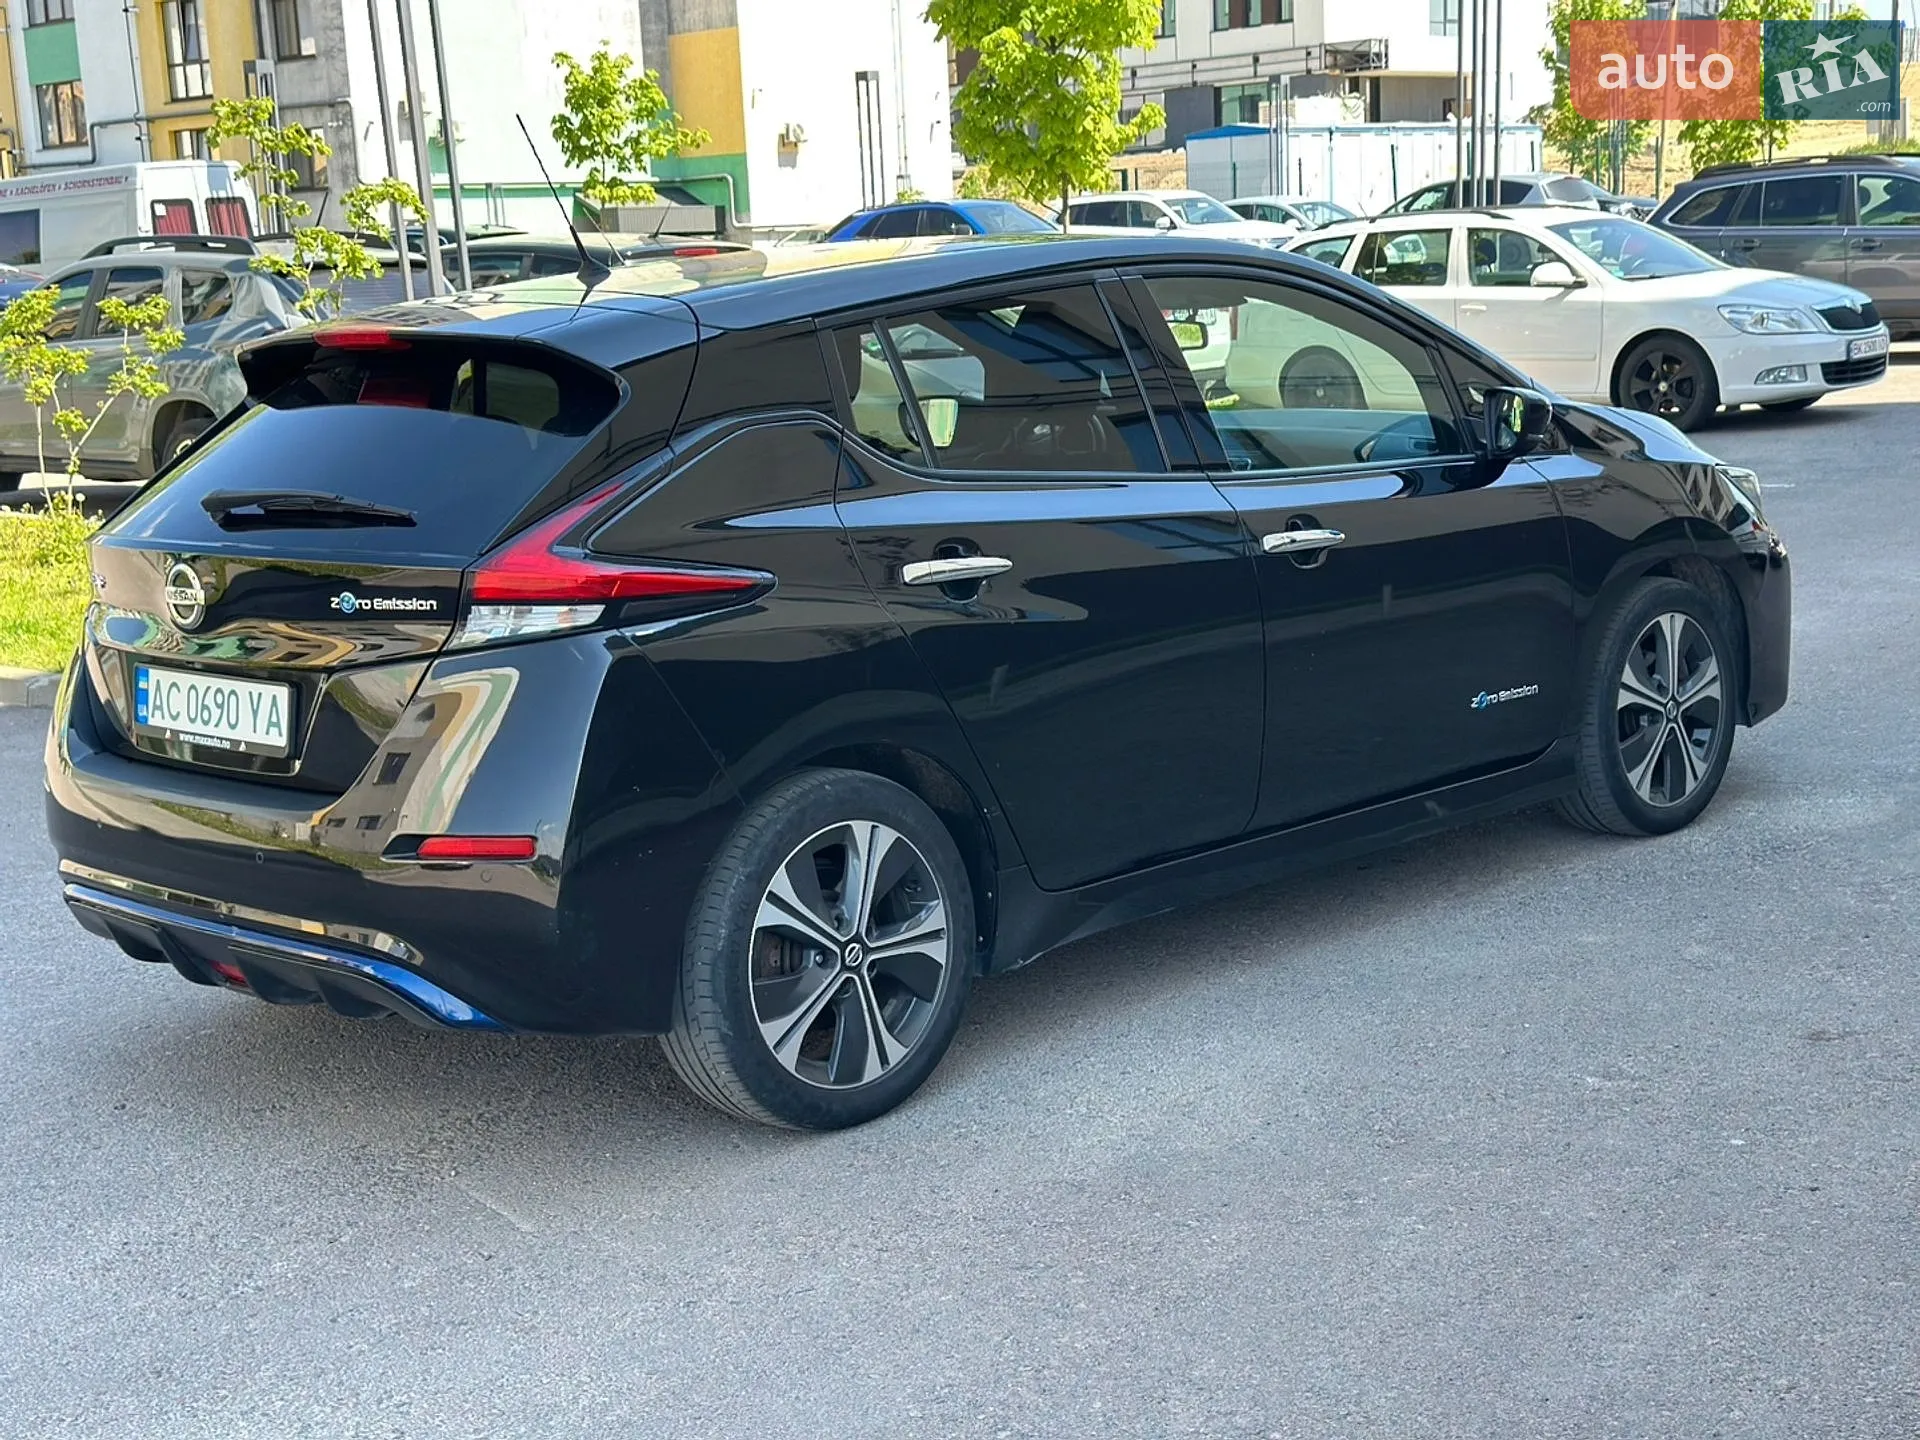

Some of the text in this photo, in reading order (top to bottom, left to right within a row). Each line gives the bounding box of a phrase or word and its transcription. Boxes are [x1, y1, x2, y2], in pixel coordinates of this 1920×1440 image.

[373, 597, 438, 611] Emission
[1498, 684, 1539, 702] Emission
[151, 678, 283, 738] AC 0690 YA
